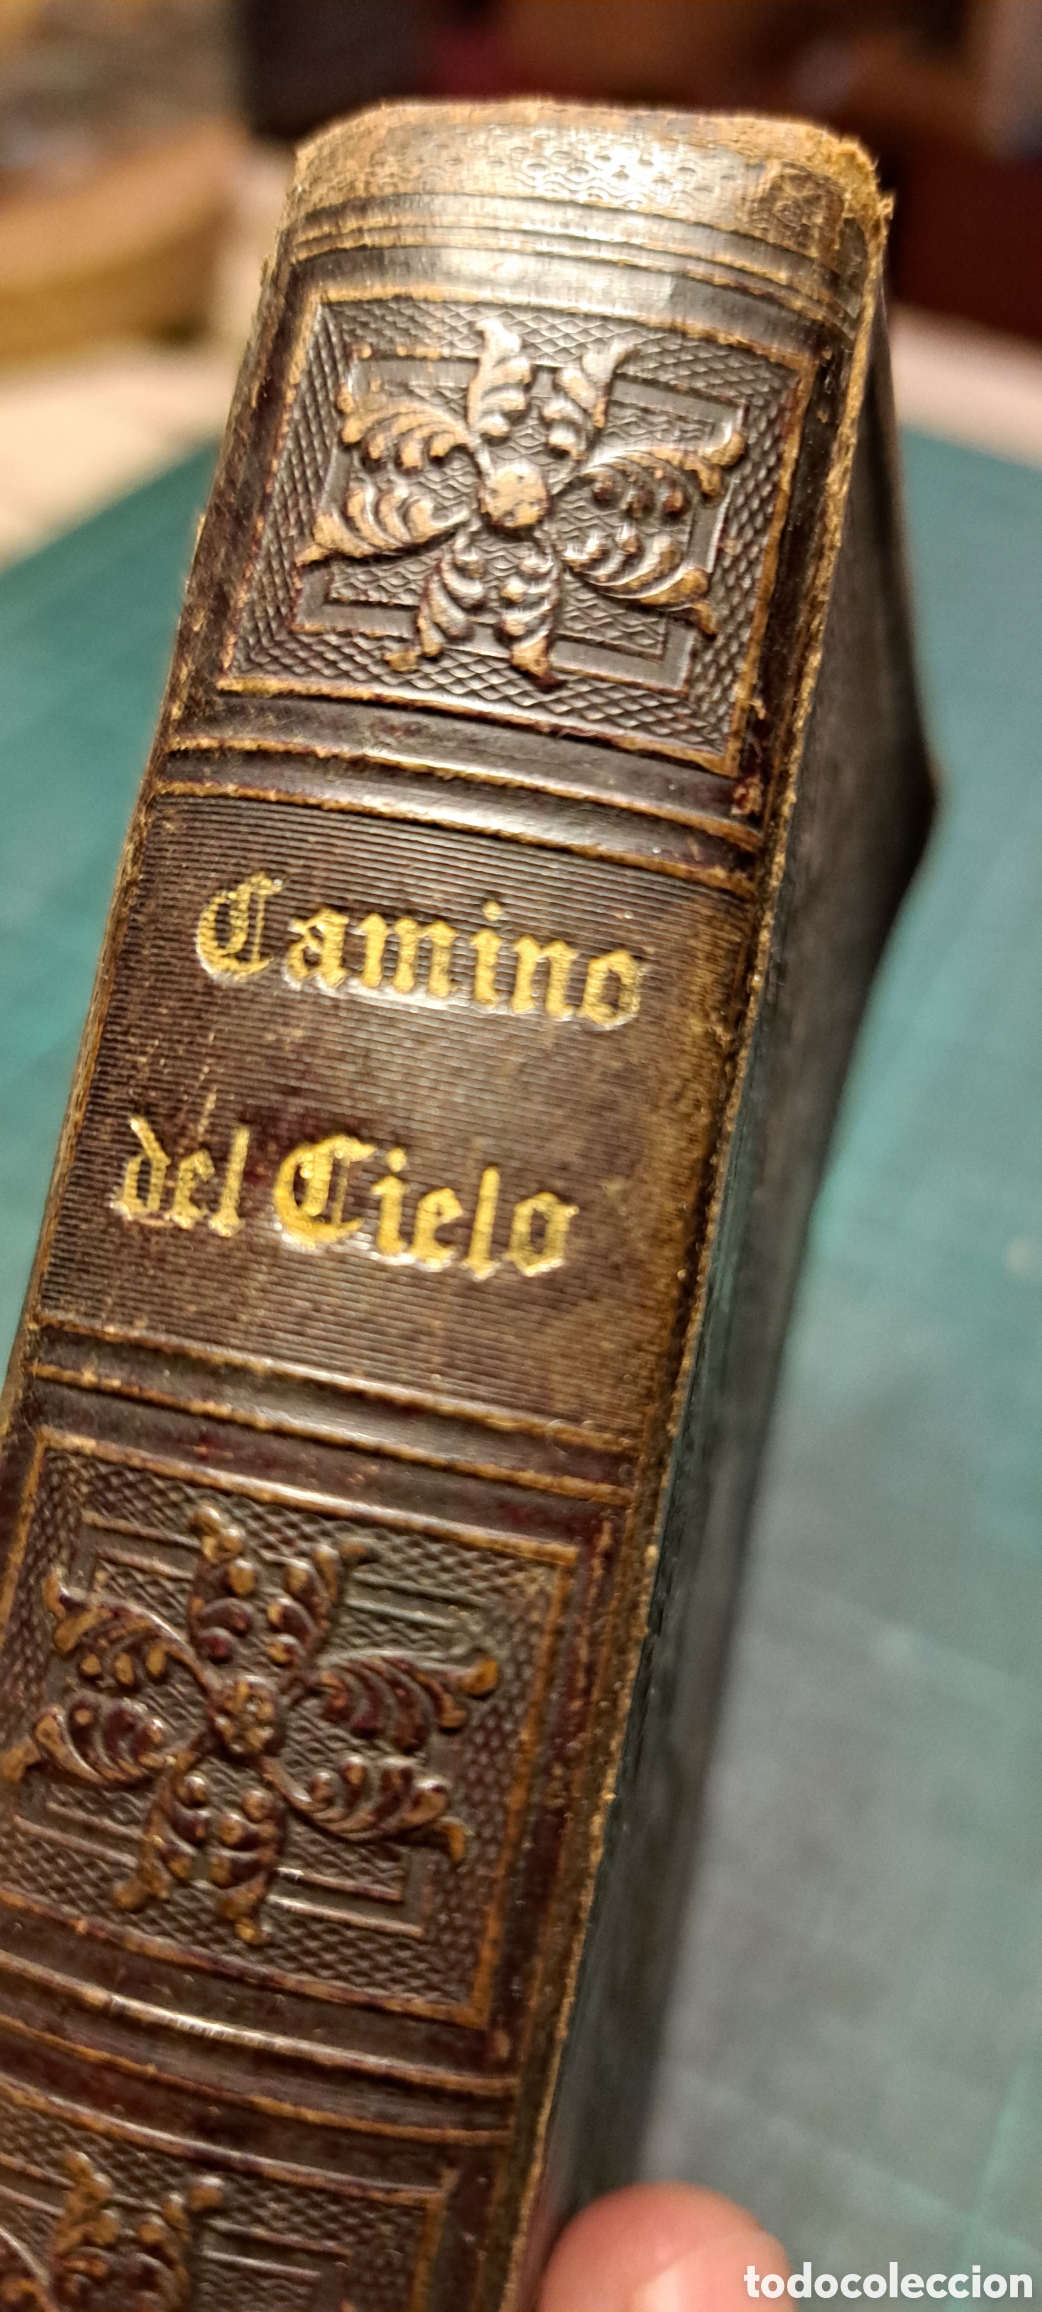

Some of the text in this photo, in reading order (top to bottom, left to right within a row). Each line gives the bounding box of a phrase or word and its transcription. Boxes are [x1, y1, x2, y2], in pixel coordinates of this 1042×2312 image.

[196, 872, 643, 1028] Camino
[111, 1116, 578, 1280] del Cielo
